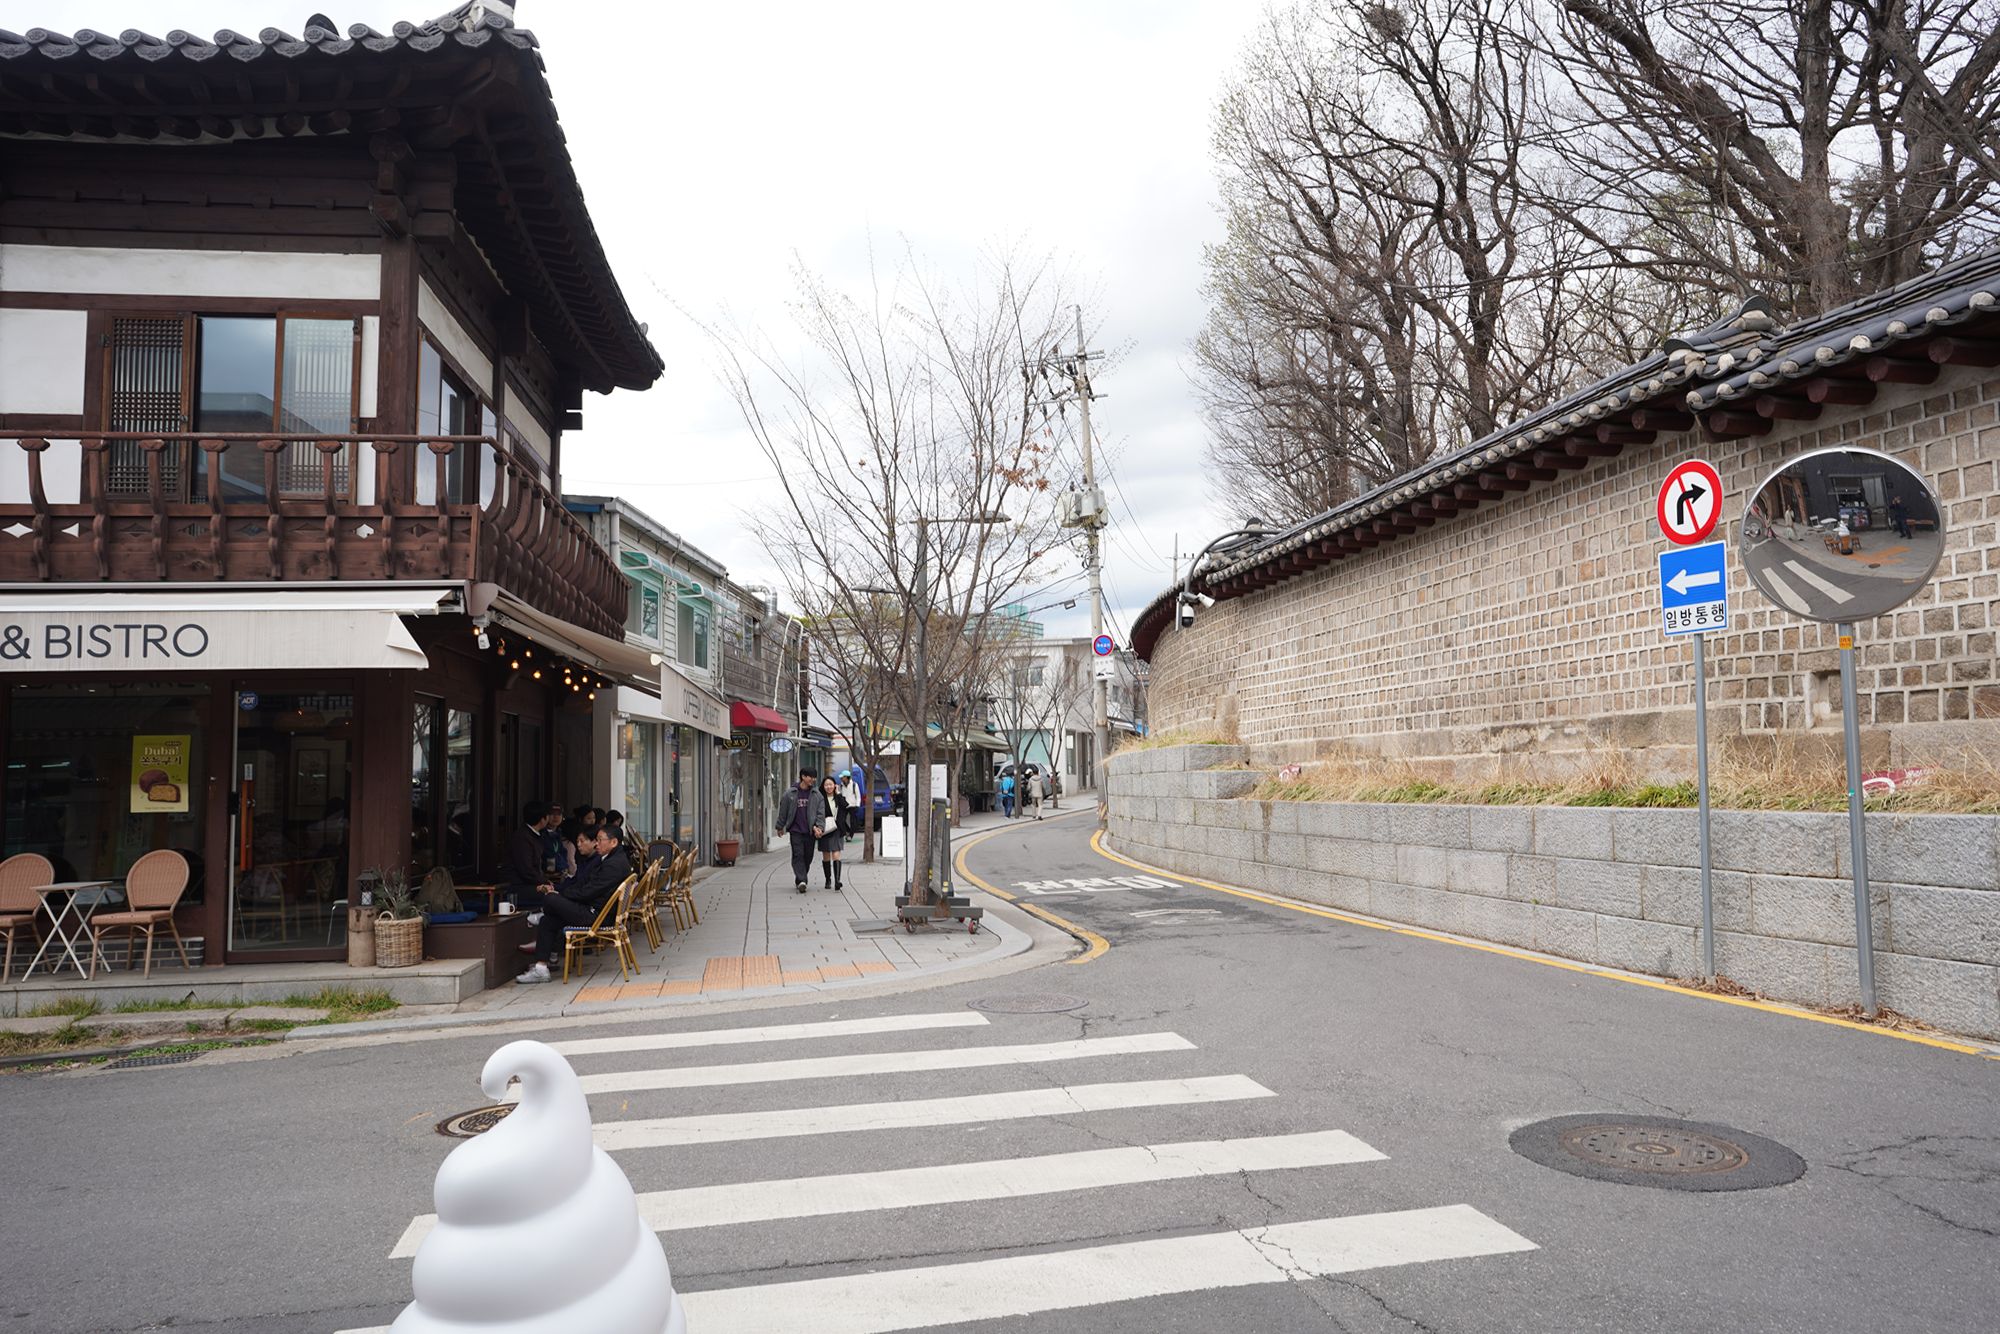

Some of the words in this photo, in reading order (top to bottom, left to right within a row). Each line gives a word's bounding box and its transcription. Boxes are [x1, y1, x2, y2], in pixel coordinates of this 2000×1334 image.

[1666, 603, 1724, 629] 일방통행
[0, 625, 31, 659] &
[45, 624, 209, 659] BISTRO
[1011, 875, 1184, 895] 천천히
